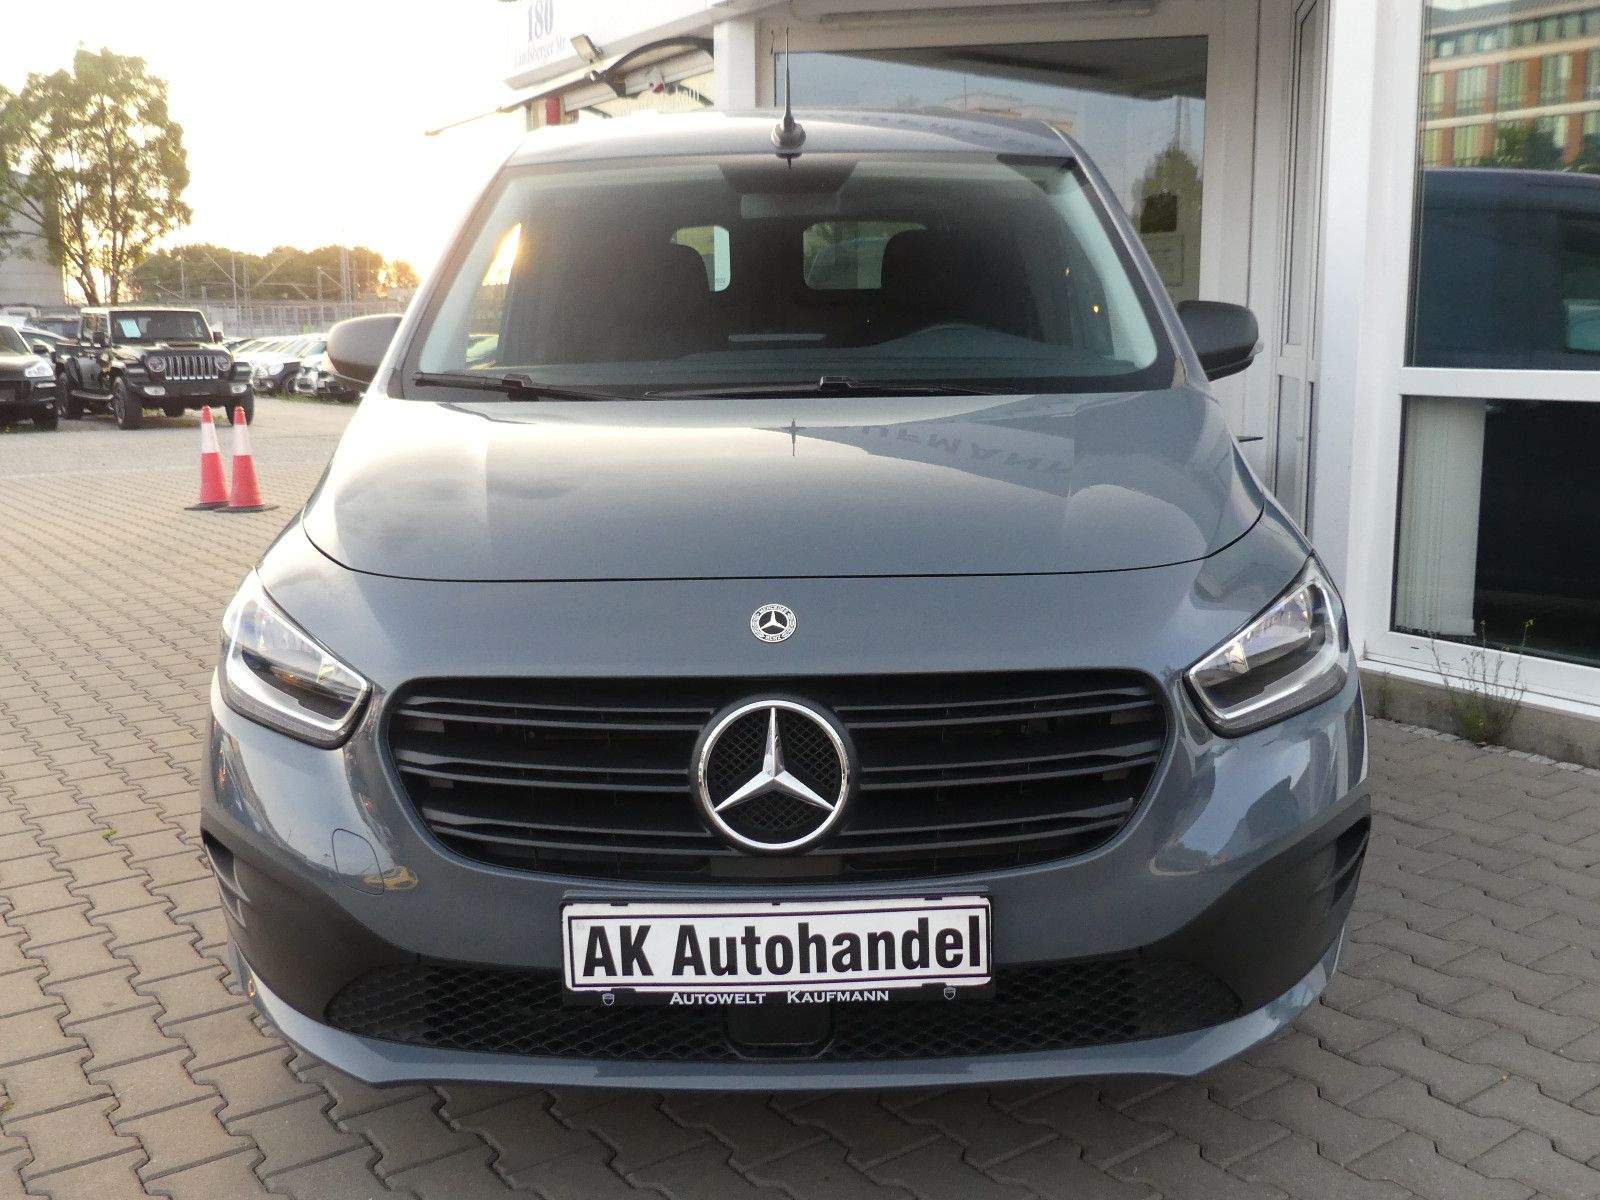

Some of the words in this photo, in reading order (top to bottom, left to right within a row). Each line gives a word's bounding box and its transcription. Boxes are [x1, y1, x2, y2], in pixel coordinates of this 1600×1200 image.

[583, 925, 654, 977] AK
[671, 915, 981, 977] Autohandel
[669, 992, 767, 1005] AUTOWELT
[787, 990, 889, 1004] KAUFMANN
